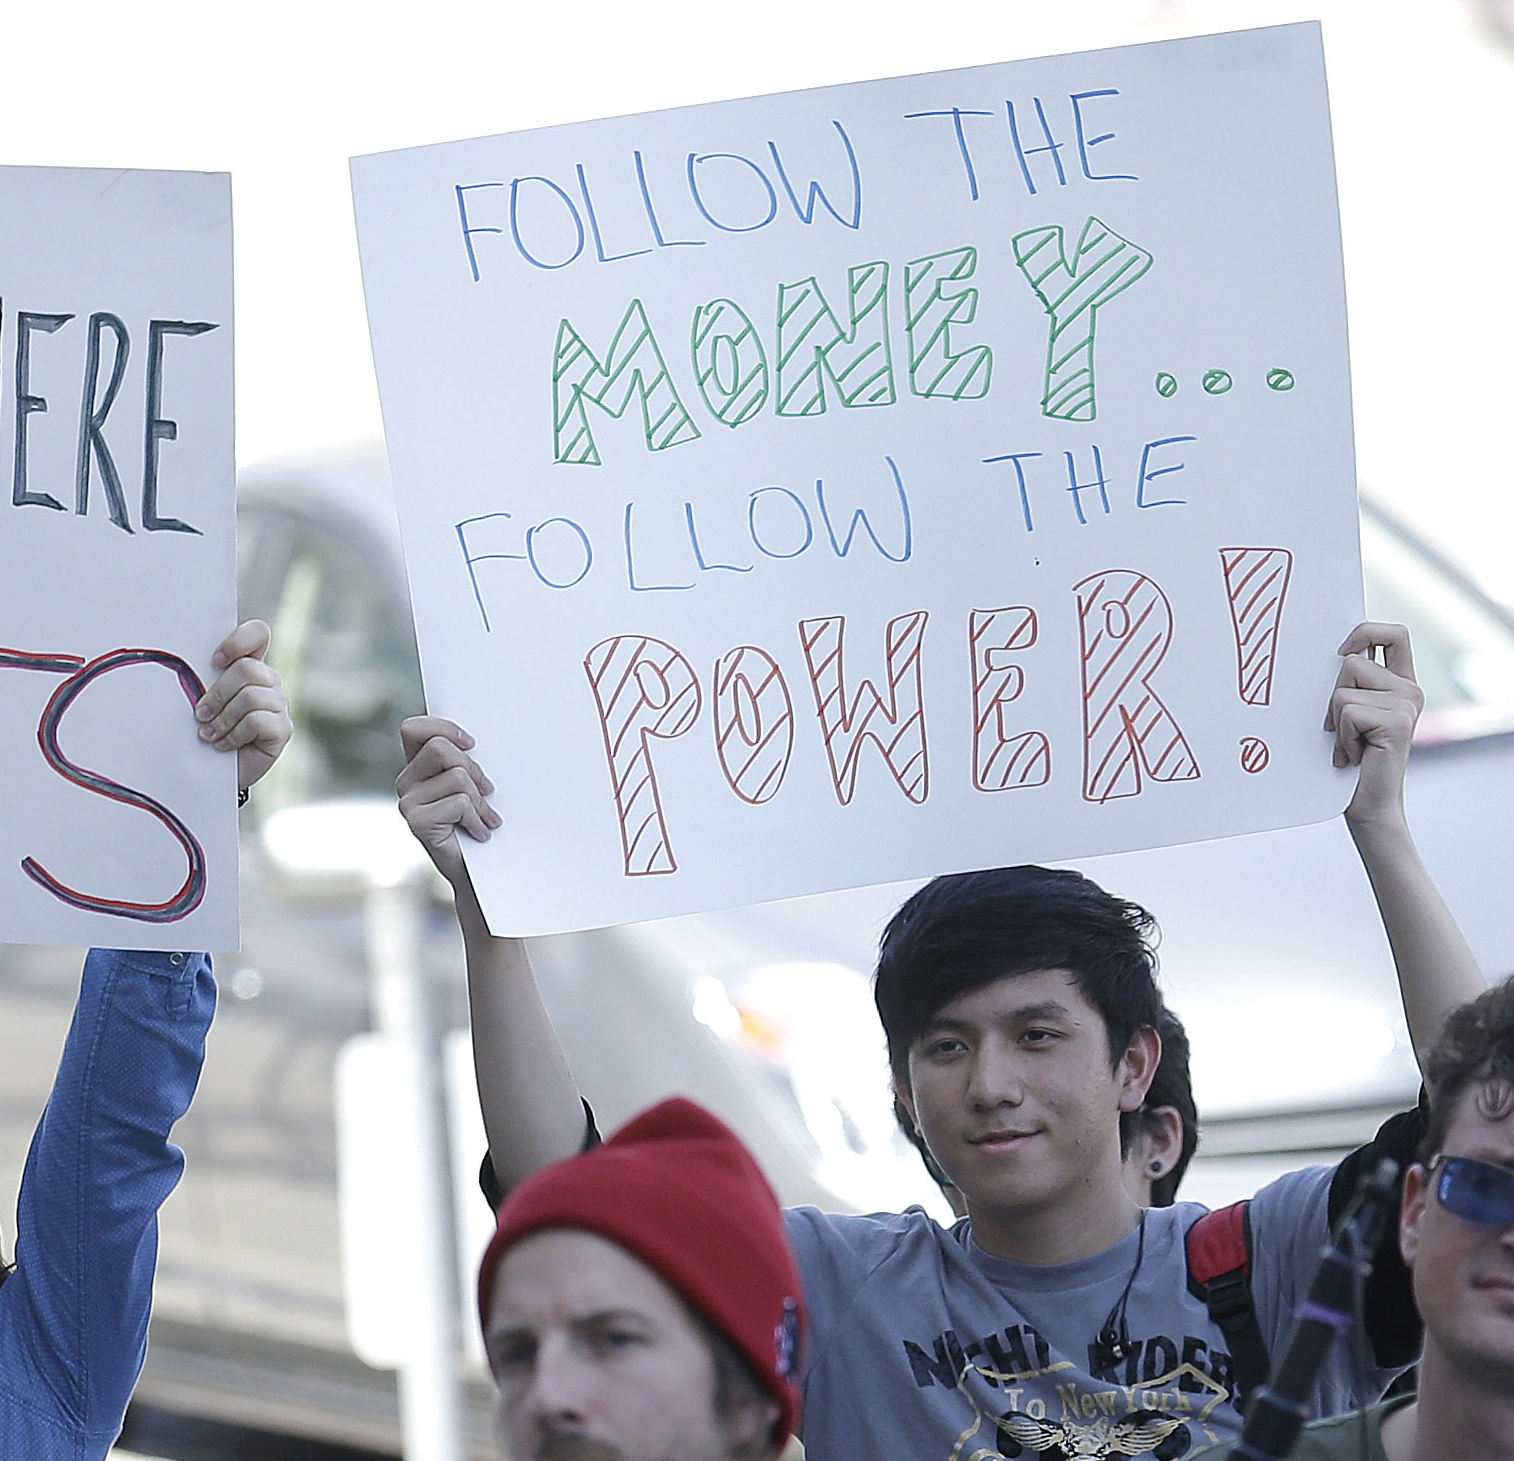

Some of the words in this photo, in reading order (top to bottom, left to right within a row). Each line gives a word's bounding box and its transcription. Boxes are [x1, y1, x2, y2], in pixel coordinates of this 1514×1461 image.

[455, 121, 861, 281] FOLLOW
[904, 89, 1138, 200] THE
[454, 455, 910, 632] FOLLOW
[982, 436, 1197, 531] THE
